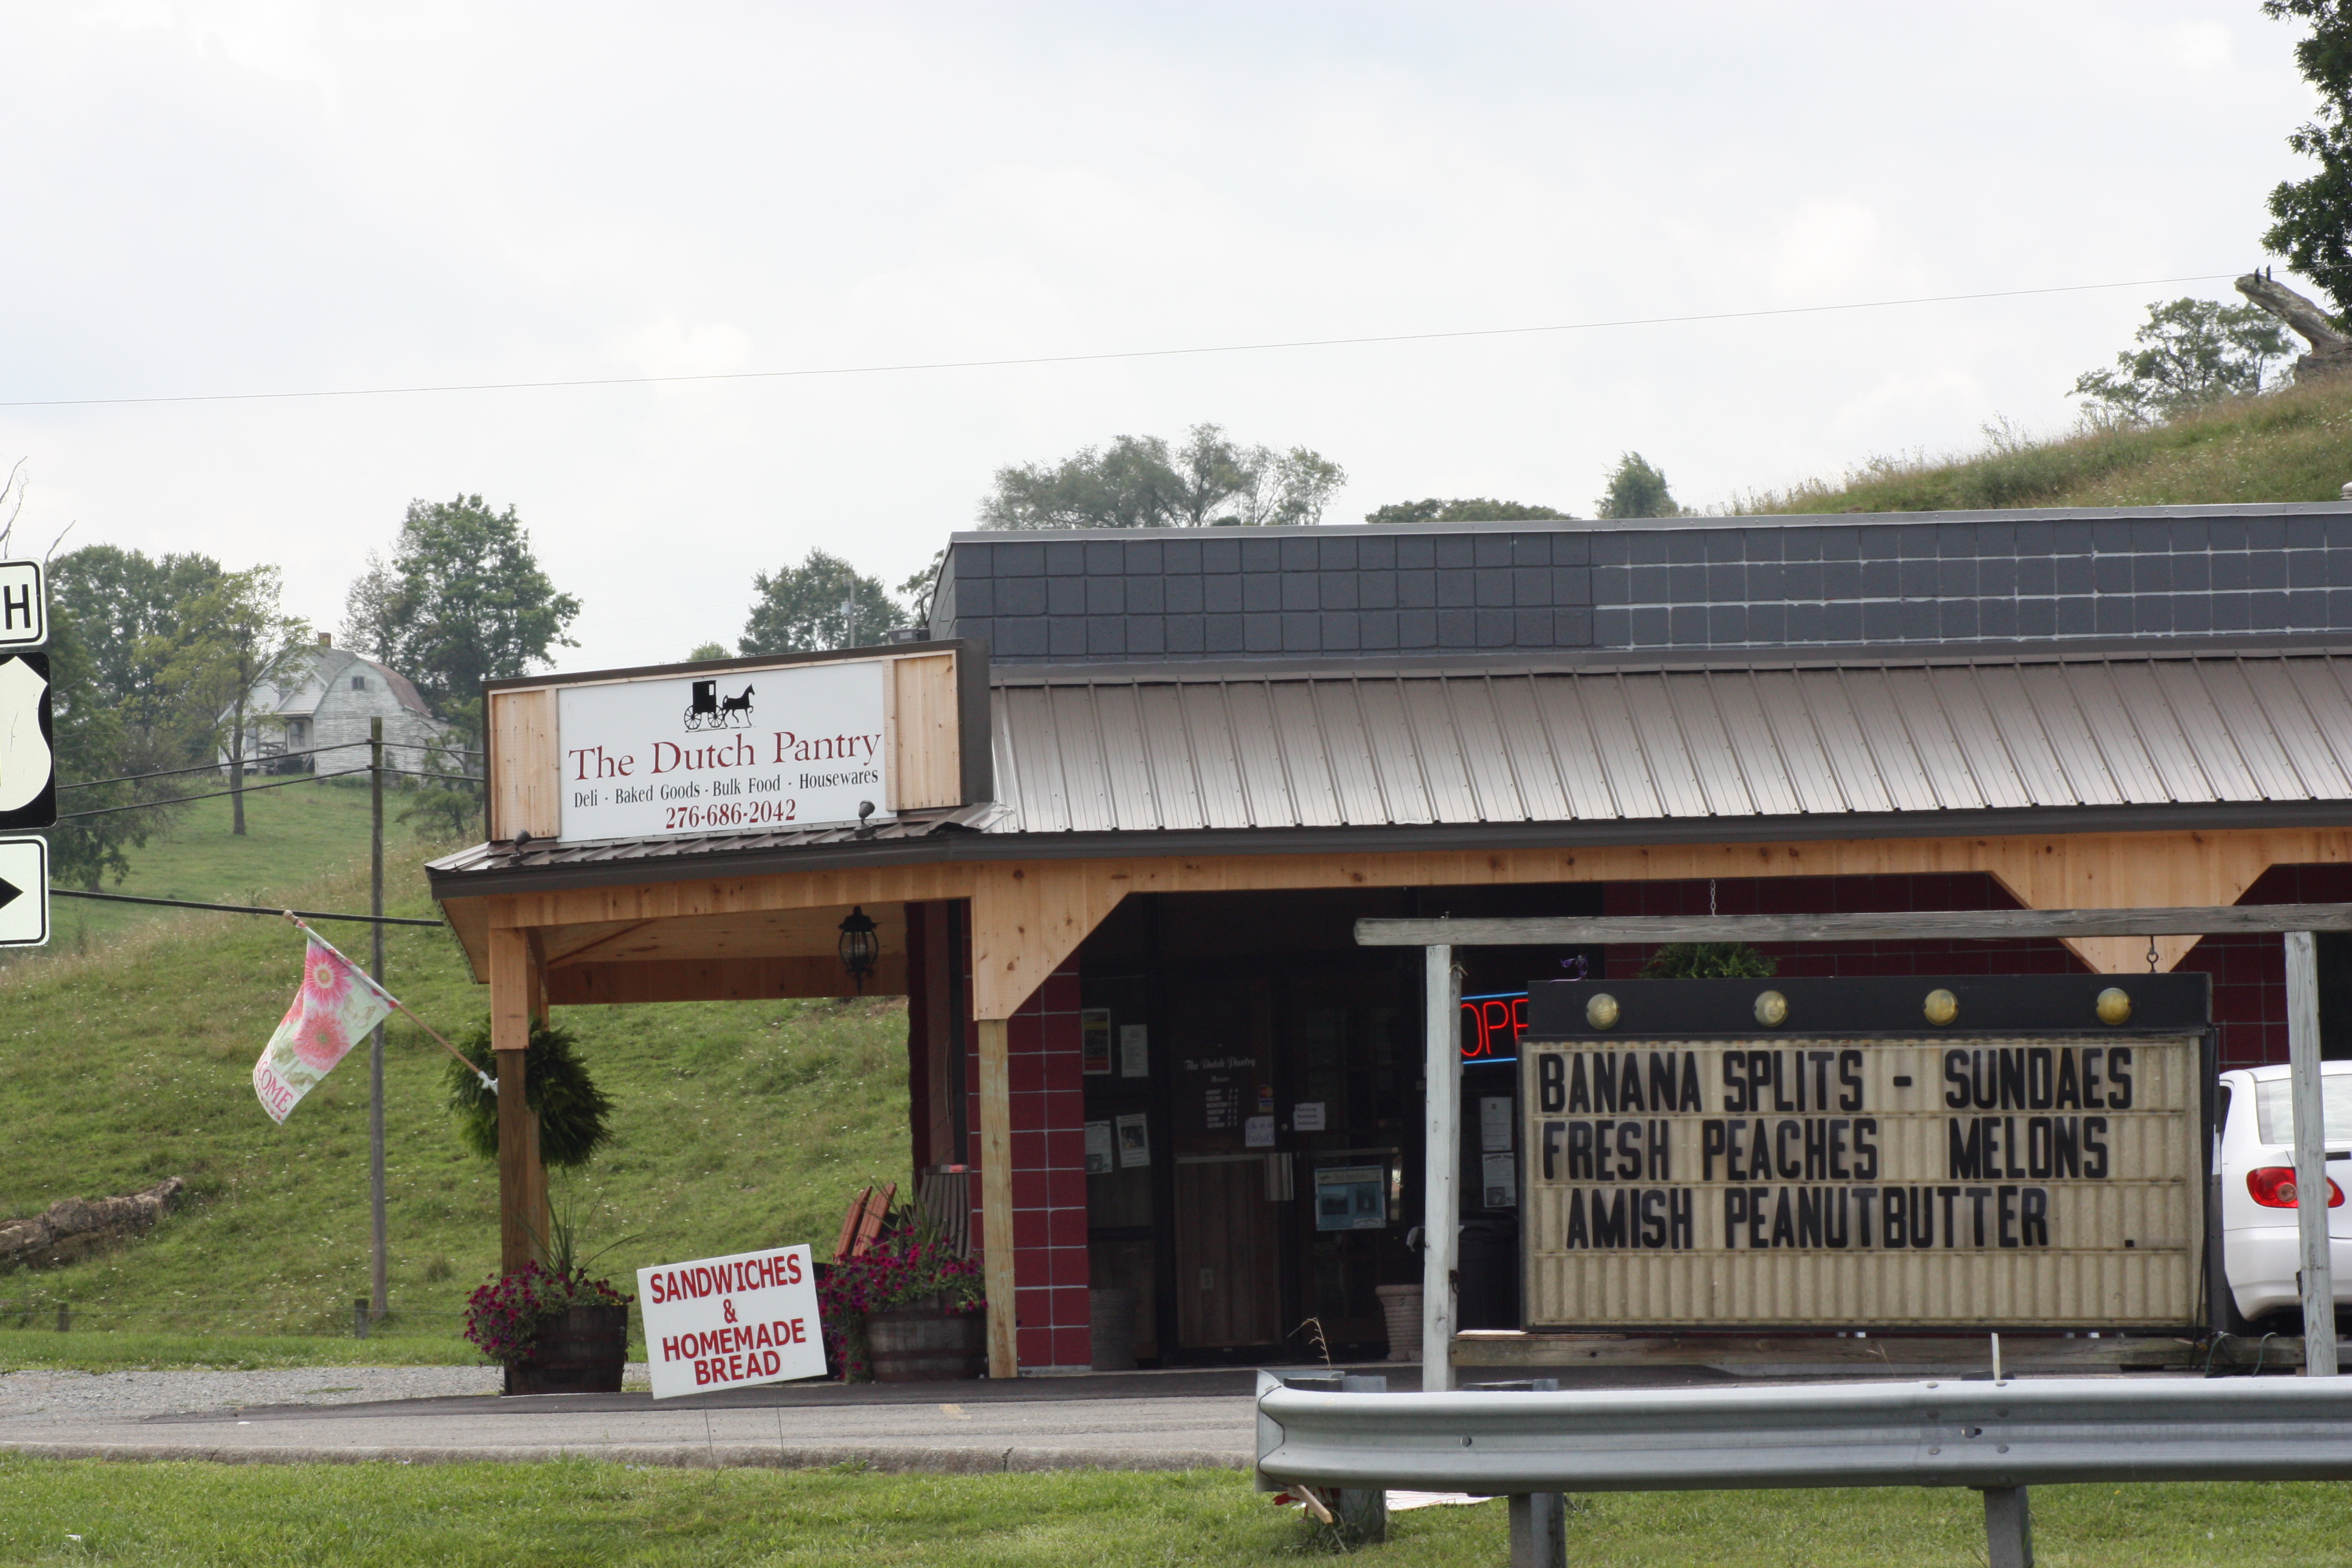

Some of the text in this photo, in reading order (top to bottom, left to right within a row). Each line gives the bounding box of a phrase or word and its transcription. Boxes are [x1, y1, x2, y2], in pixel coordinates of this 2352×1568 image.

[569, 731, 881, 781] The Dutch Pantry
[574, 789, 598, 808] Deli
[615, 785, 653, 805] Baked
[660, 781, 700, 801] Goods
[712, 778, 741, 797] Bulk
[748, 774, 780, 793] Food
[799, 769, 878, 790] Housewares
[665, 799, 796, 829] 276-686-2042
[1184, 1056, 1256, 1071] The Dutch Pantry
[1538, 1051, 1702, 1113] BANANA
[1722, 1050, 1863, 1113] SPLITS
[1944, 1047, 2132, 1110] SUNDAES
[1543, 1119, 1670, 1181] FRESH
[1702, 1118, 1877, 1181] PEACHES
[1949, 1117, 2108, 1180] MELONS
[1566, 1188, 1693, 1250] AMISH
[650, 1254, 802, 1304] SANDWICHES
[723, 1299, 738, 1324] &
[663, 1318, 807, 1362] HOMEMADE
[694, 1351, 781, 1386] BREAD
